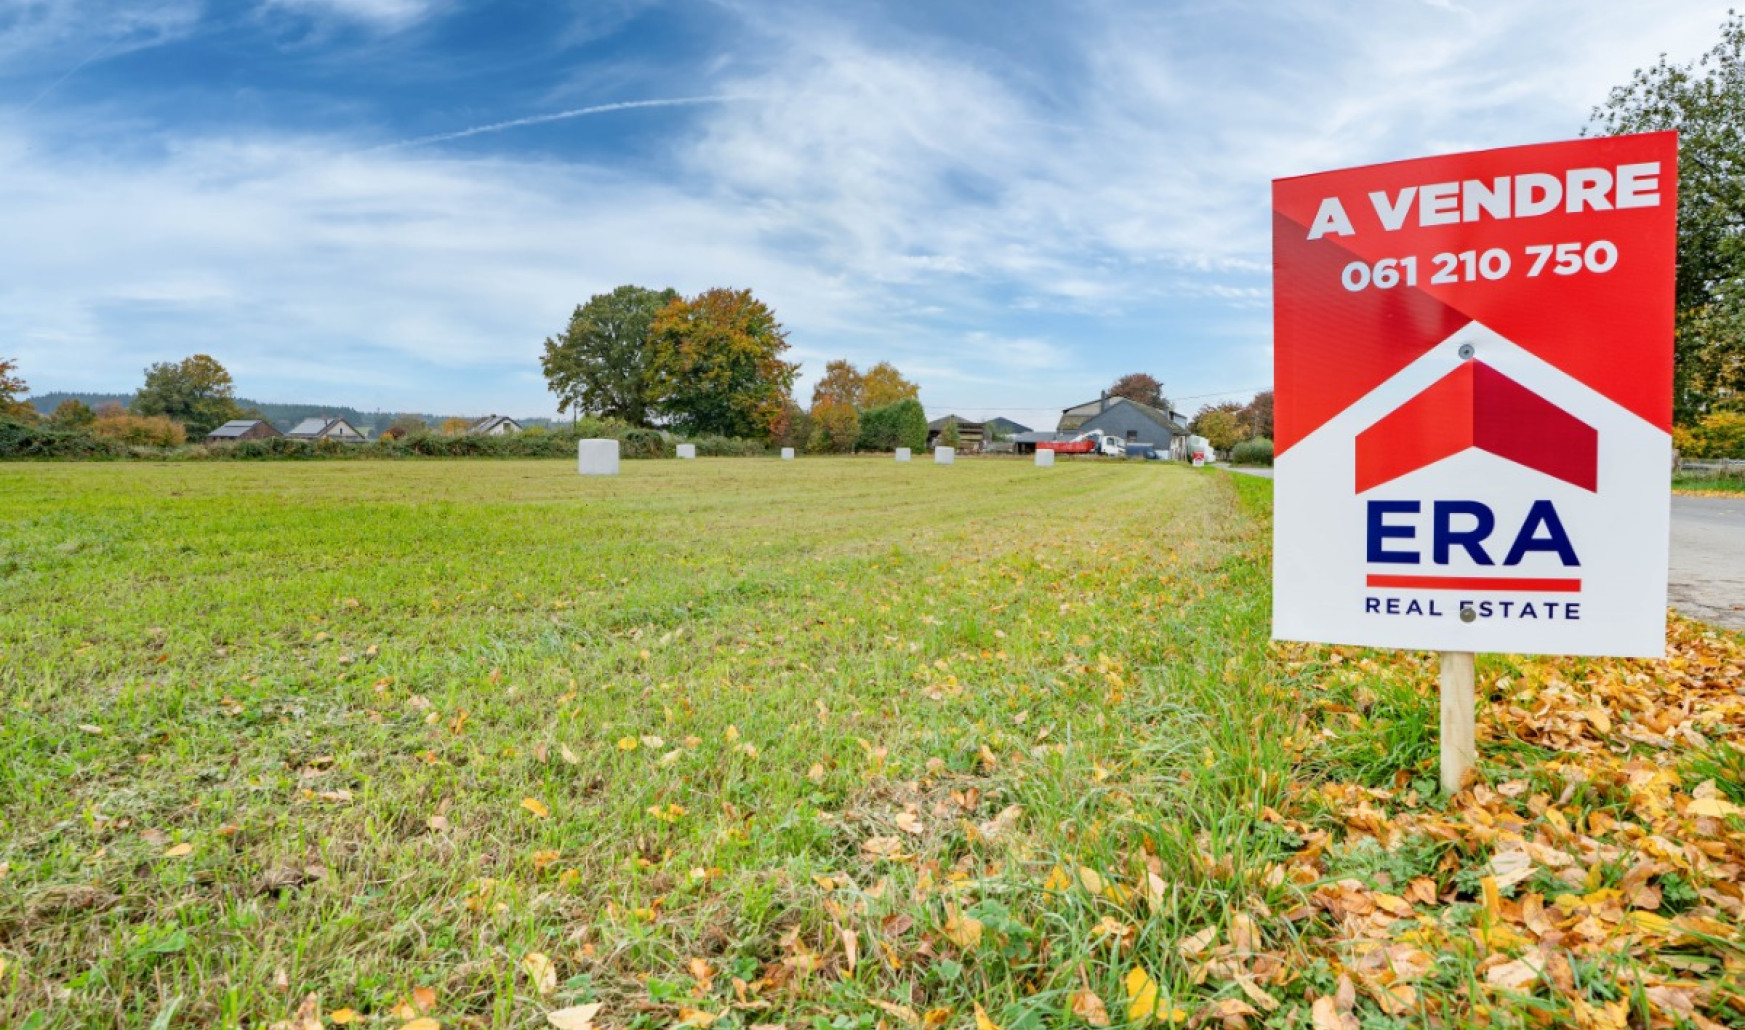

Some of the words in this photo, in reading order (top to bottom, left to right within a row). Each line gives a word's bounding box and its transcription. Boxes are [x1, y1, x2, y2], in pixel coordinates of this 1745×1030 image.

[1306, 196, 1356, 241] A
[1367, 161, 1661, 232] VENDRE
[1341, 255, 1418, 292] 061
[1430, 247, 1512, 285] 210
[1525, 240, 1619, 278] 750
[1366, 499, 1582, 567] ERA
[1365, 596, 1443, 617] REAL
